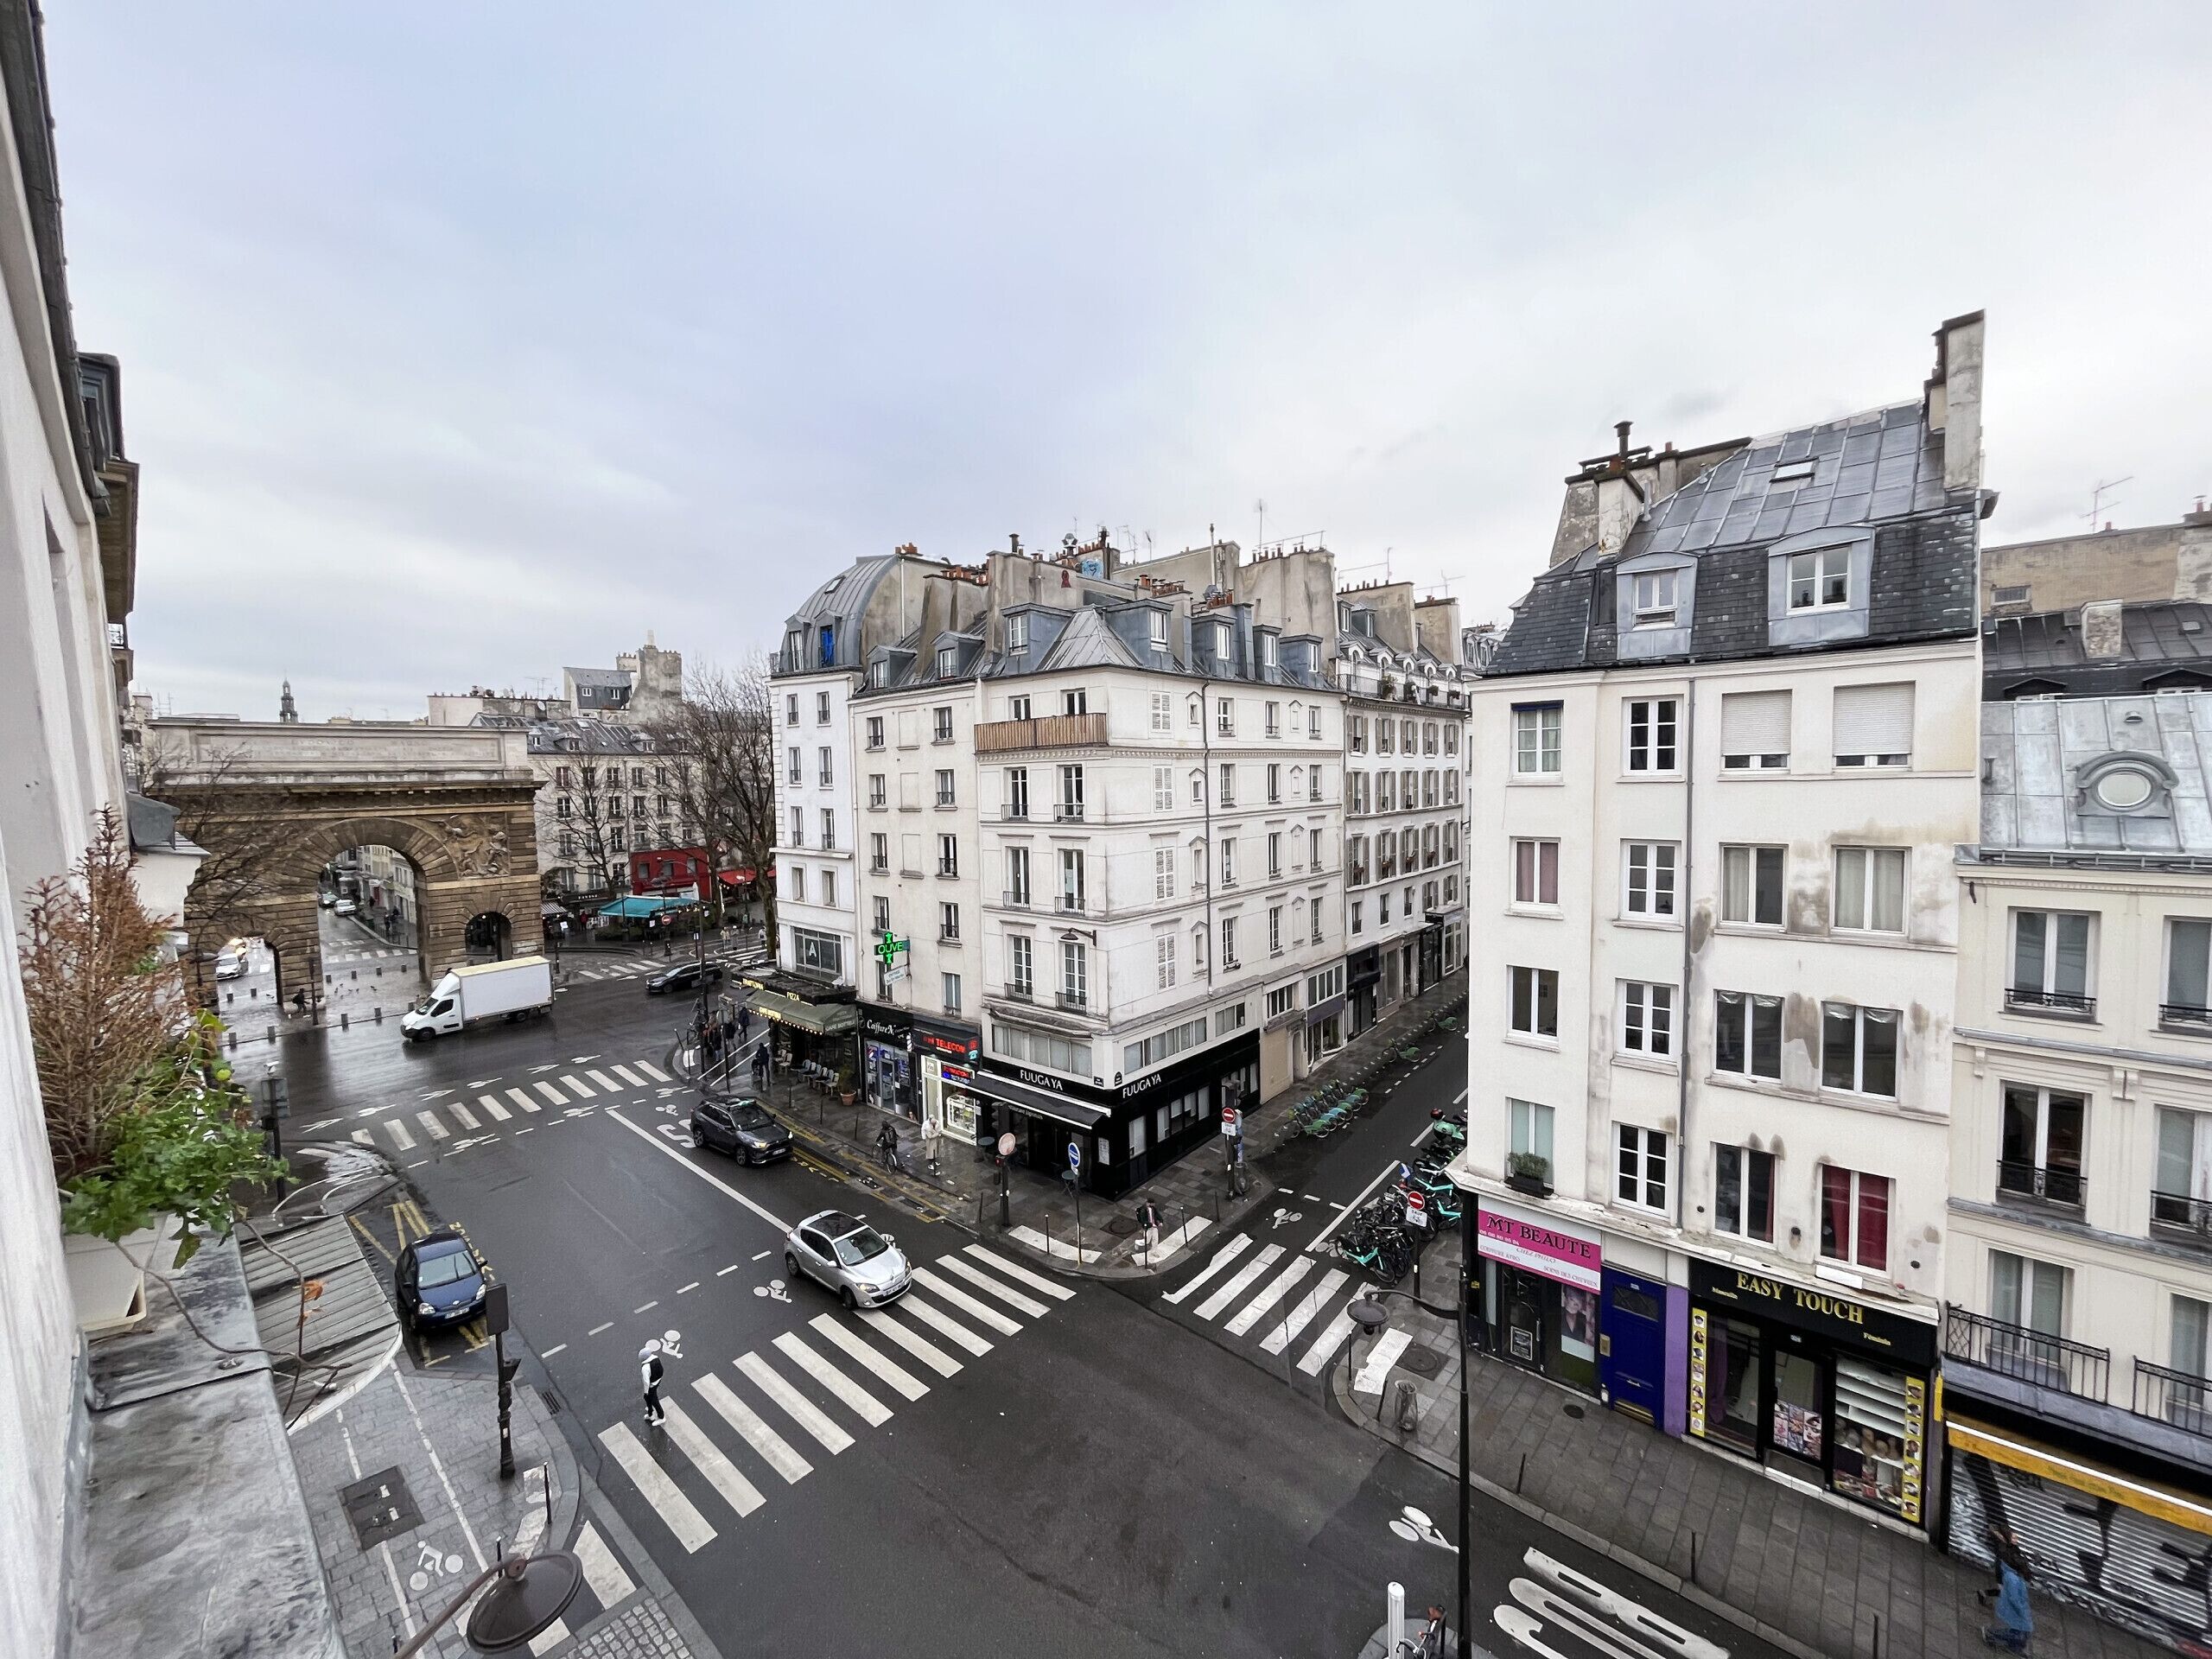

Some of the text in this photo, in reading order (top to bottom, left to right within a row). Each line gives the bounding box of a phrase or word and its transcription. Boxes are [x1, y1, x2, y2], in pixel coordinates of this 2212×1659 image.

[809, 941, 817, 957] A
[786, 991, 800, 1001] PIZZA
[936, 1038, 966, 1054] TELECOM
[1487, 1215, 1592, 1259] MT BEAUTE
[1736, 1272, 1865, 1325] EASY TOUCH
